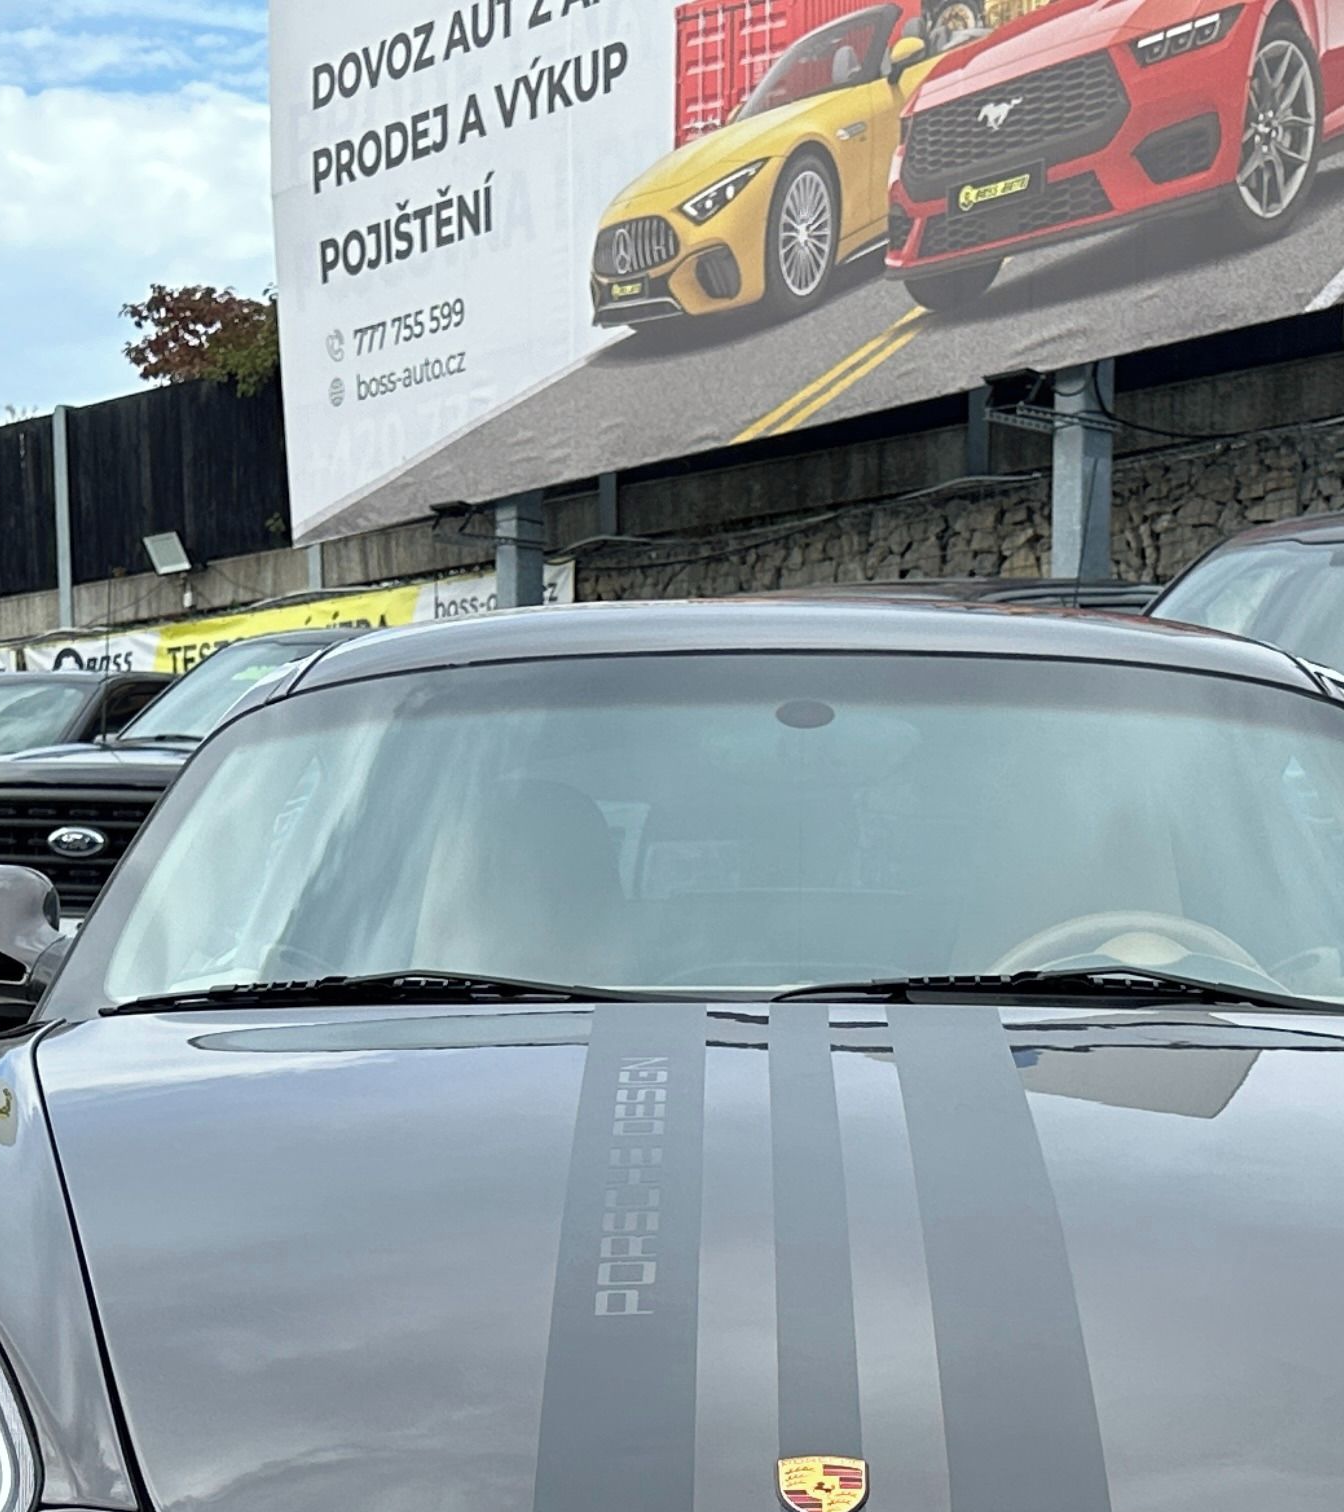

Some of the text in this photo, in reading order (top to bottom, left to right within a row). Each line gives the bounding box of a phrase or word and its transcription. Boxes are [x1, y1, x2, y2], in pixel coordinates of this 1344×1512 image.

[313, 20, 435, 110] DOVOZ
[443, 0, 511, 61] AUT
[313, 41, 628, 195] PRODEJ A VÝKUP
[319, 170, 496, 285] POJIŠTĚNÍ
[353, 297, 466, 357] 777 755 599
[356, 351, 467, 401] boss-auto.cz
[594, 1056, 669, 1317] PORSCHE DESIGN
